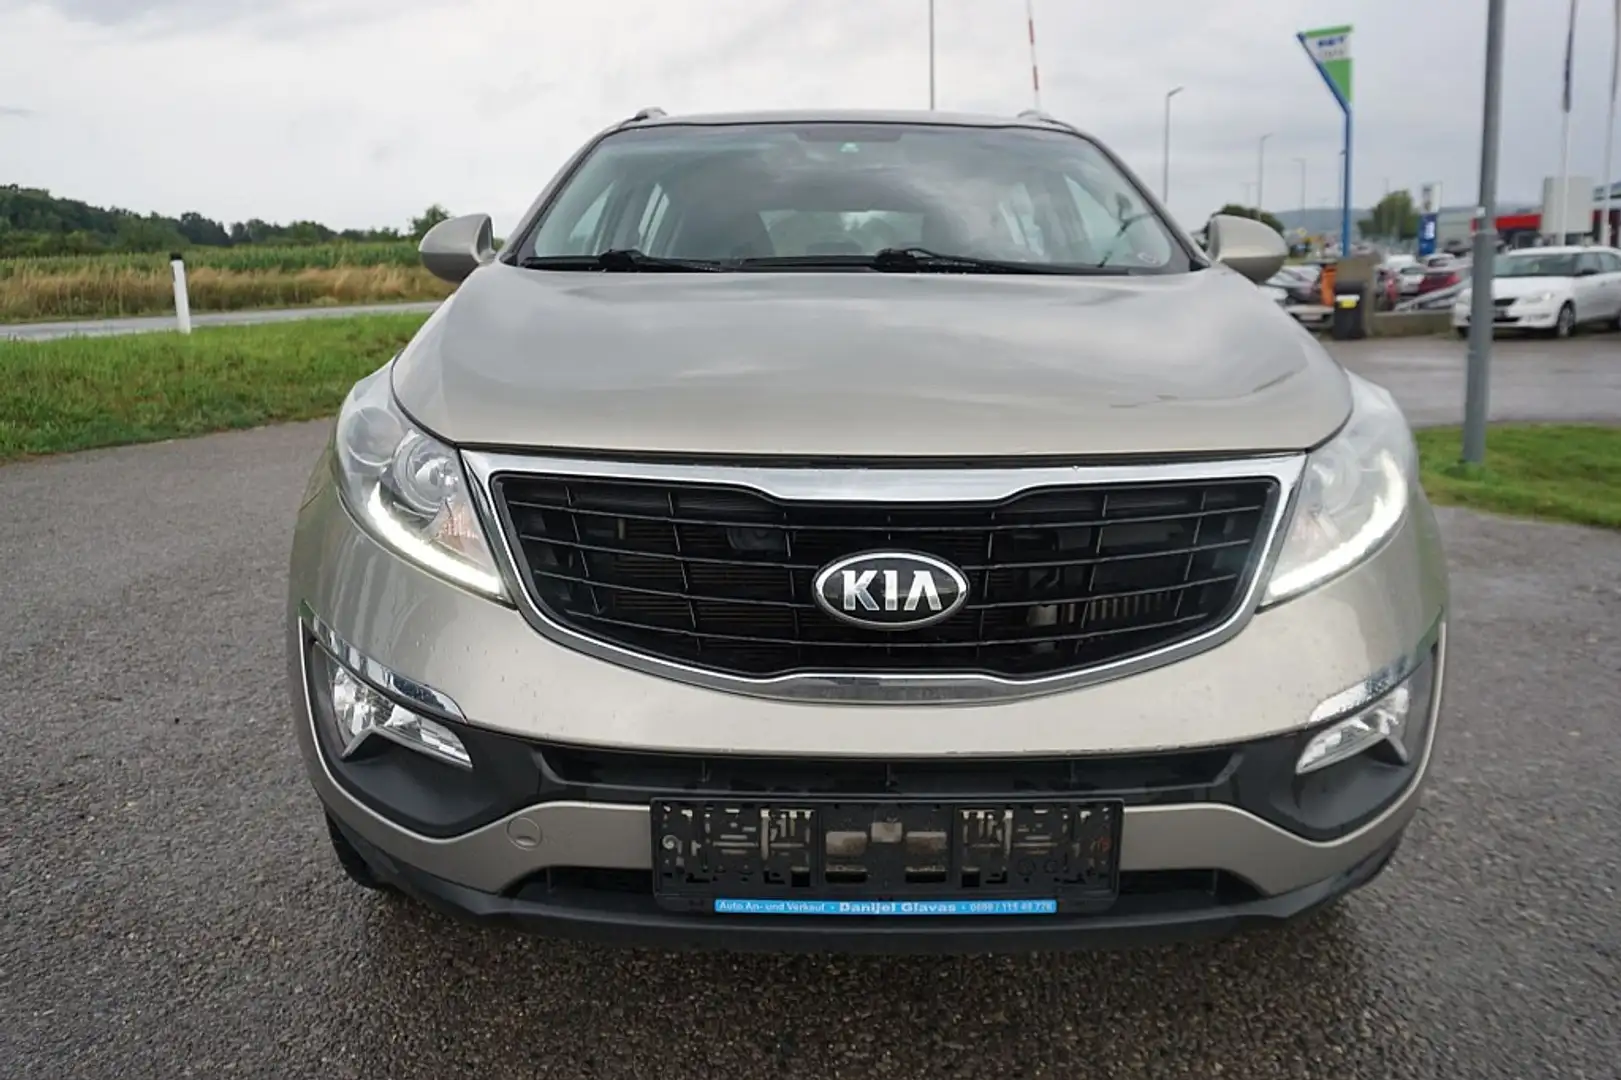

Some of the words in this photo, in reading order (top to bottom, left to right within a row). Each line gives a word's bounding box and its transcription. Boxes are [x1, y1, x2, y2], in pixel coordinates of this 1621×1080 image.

[841, 570, 943, 611] KIA
[719, 901, 744, 911] Auto
[765, 902, 785, 911] und
[786, 901, 825, 912] Verkauf
[839, 901, 896, 914] Danijel
[901, 902, 957, 913] Glavas
